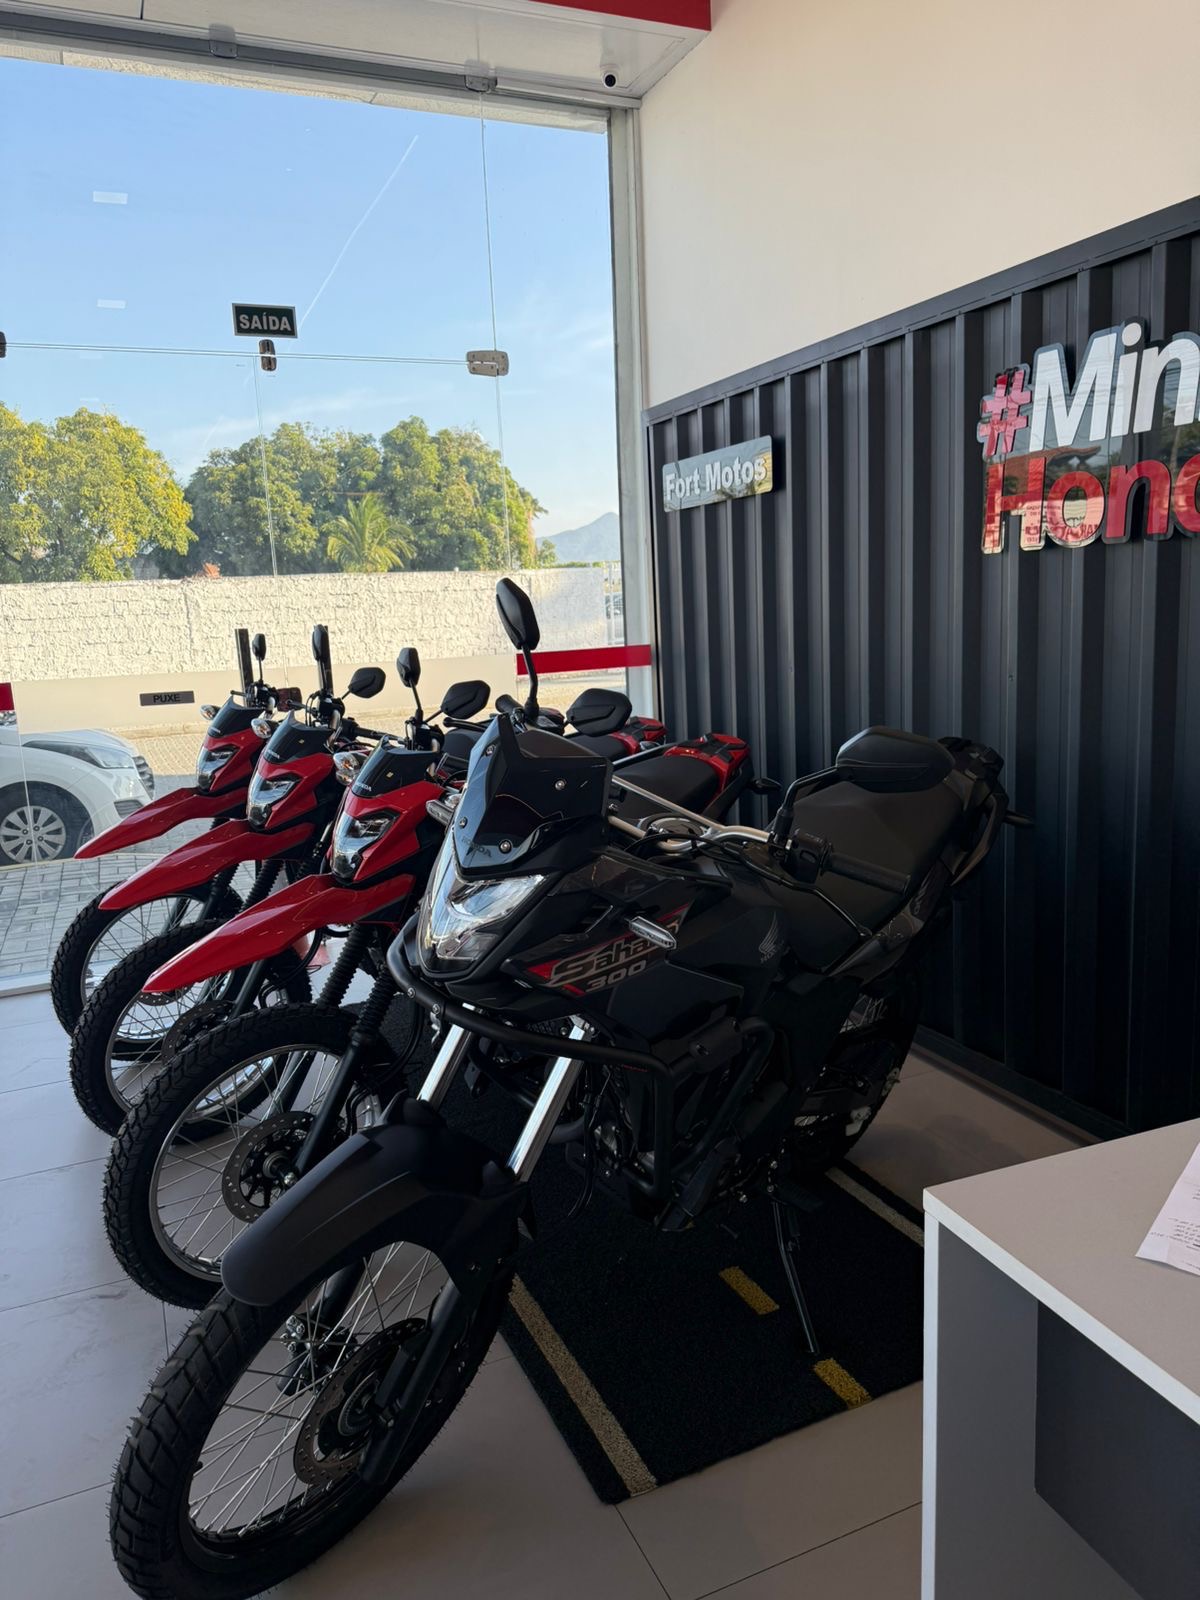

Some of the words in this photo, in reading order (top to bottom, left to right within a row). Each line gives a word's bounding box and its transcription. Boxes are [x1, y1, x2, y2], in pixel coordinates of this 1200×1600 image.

[239, 312, 291, 331] SAÍDA
[979, 322, 1200, 456] #Min
[665, 467, 700, 501] Fort
[705, 456, 766, 493] Motos
[152, 693, 181, 703] PUXE
[551, 920, 679, 983] Saha
[586, 960, 647, 992] 300
